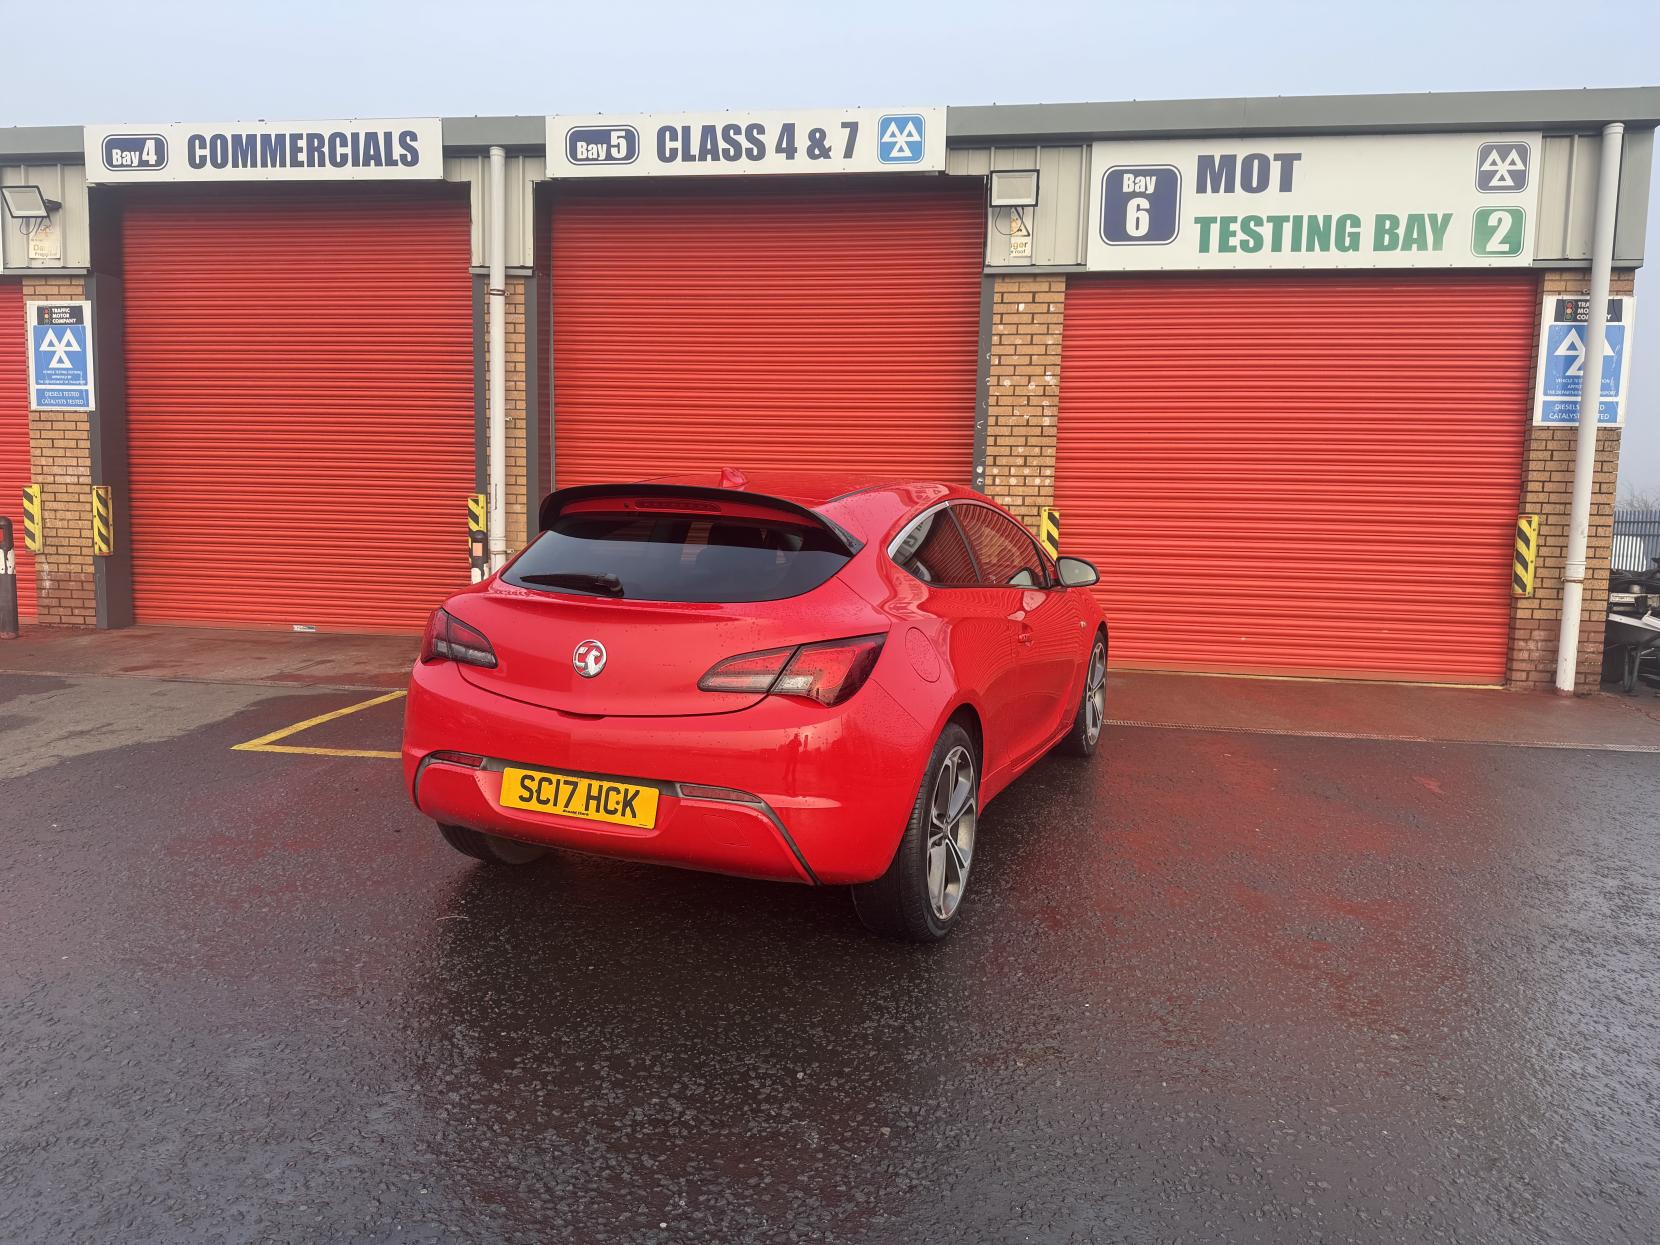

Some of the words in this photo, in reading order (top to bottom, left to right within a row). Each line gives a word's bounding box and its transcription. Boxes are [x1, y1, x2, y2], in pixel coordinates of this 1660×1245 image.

[112, 150, 139, 167] Bay
[141, 139, 157, 165] 4
[187, 130, 420, 169] COMMERCIALS
[576, 141, 607, 161] Bay
[610, 131, 627, 157] 5
[656, 122, 766, 163] CLASS
[775, 122, 798, 160] 4
[806, 127, 832, 160] &
[840, 121, 859, 159] 7
[1122, 173, 1156, 195] Bay
[1195, 152, 1302, 195] MOT
[1126, 197, 1150, 237] 6
[1194, 213, 1363, 253] TESTING
[1373, 212, 1454, 252] BAY
[1485, 210, 1513, 253] 2
[518, 774, 579, 809] SC17
[584, 782, 641, 819] HCK
